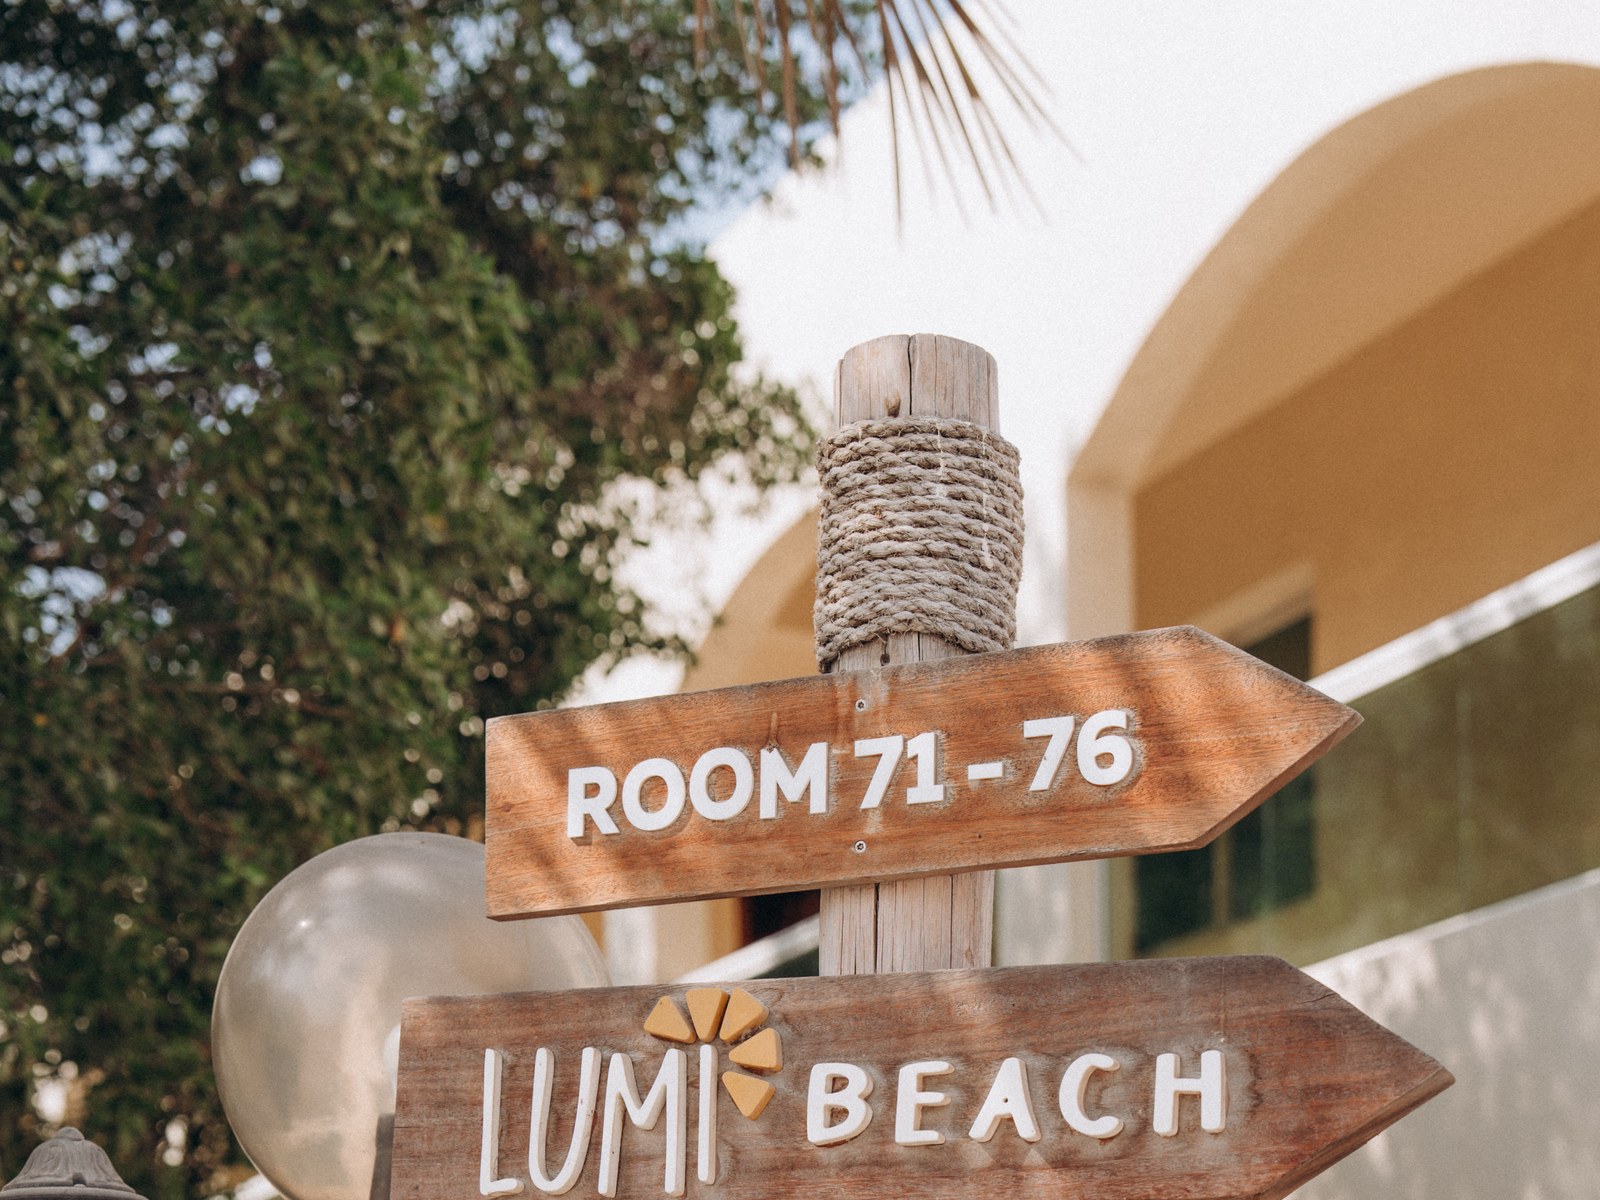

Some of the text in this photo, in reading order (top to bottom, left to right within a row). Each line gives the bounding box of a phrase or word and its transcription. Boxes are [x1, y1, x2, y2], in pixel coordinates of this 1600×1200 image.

[567, 742, 828, 838] ROOM
[853, 732, 944, 809] 71
[1022, 709, 1133, 791] 76
[479, 1043, 1227, 1198] LUMI BEACH
